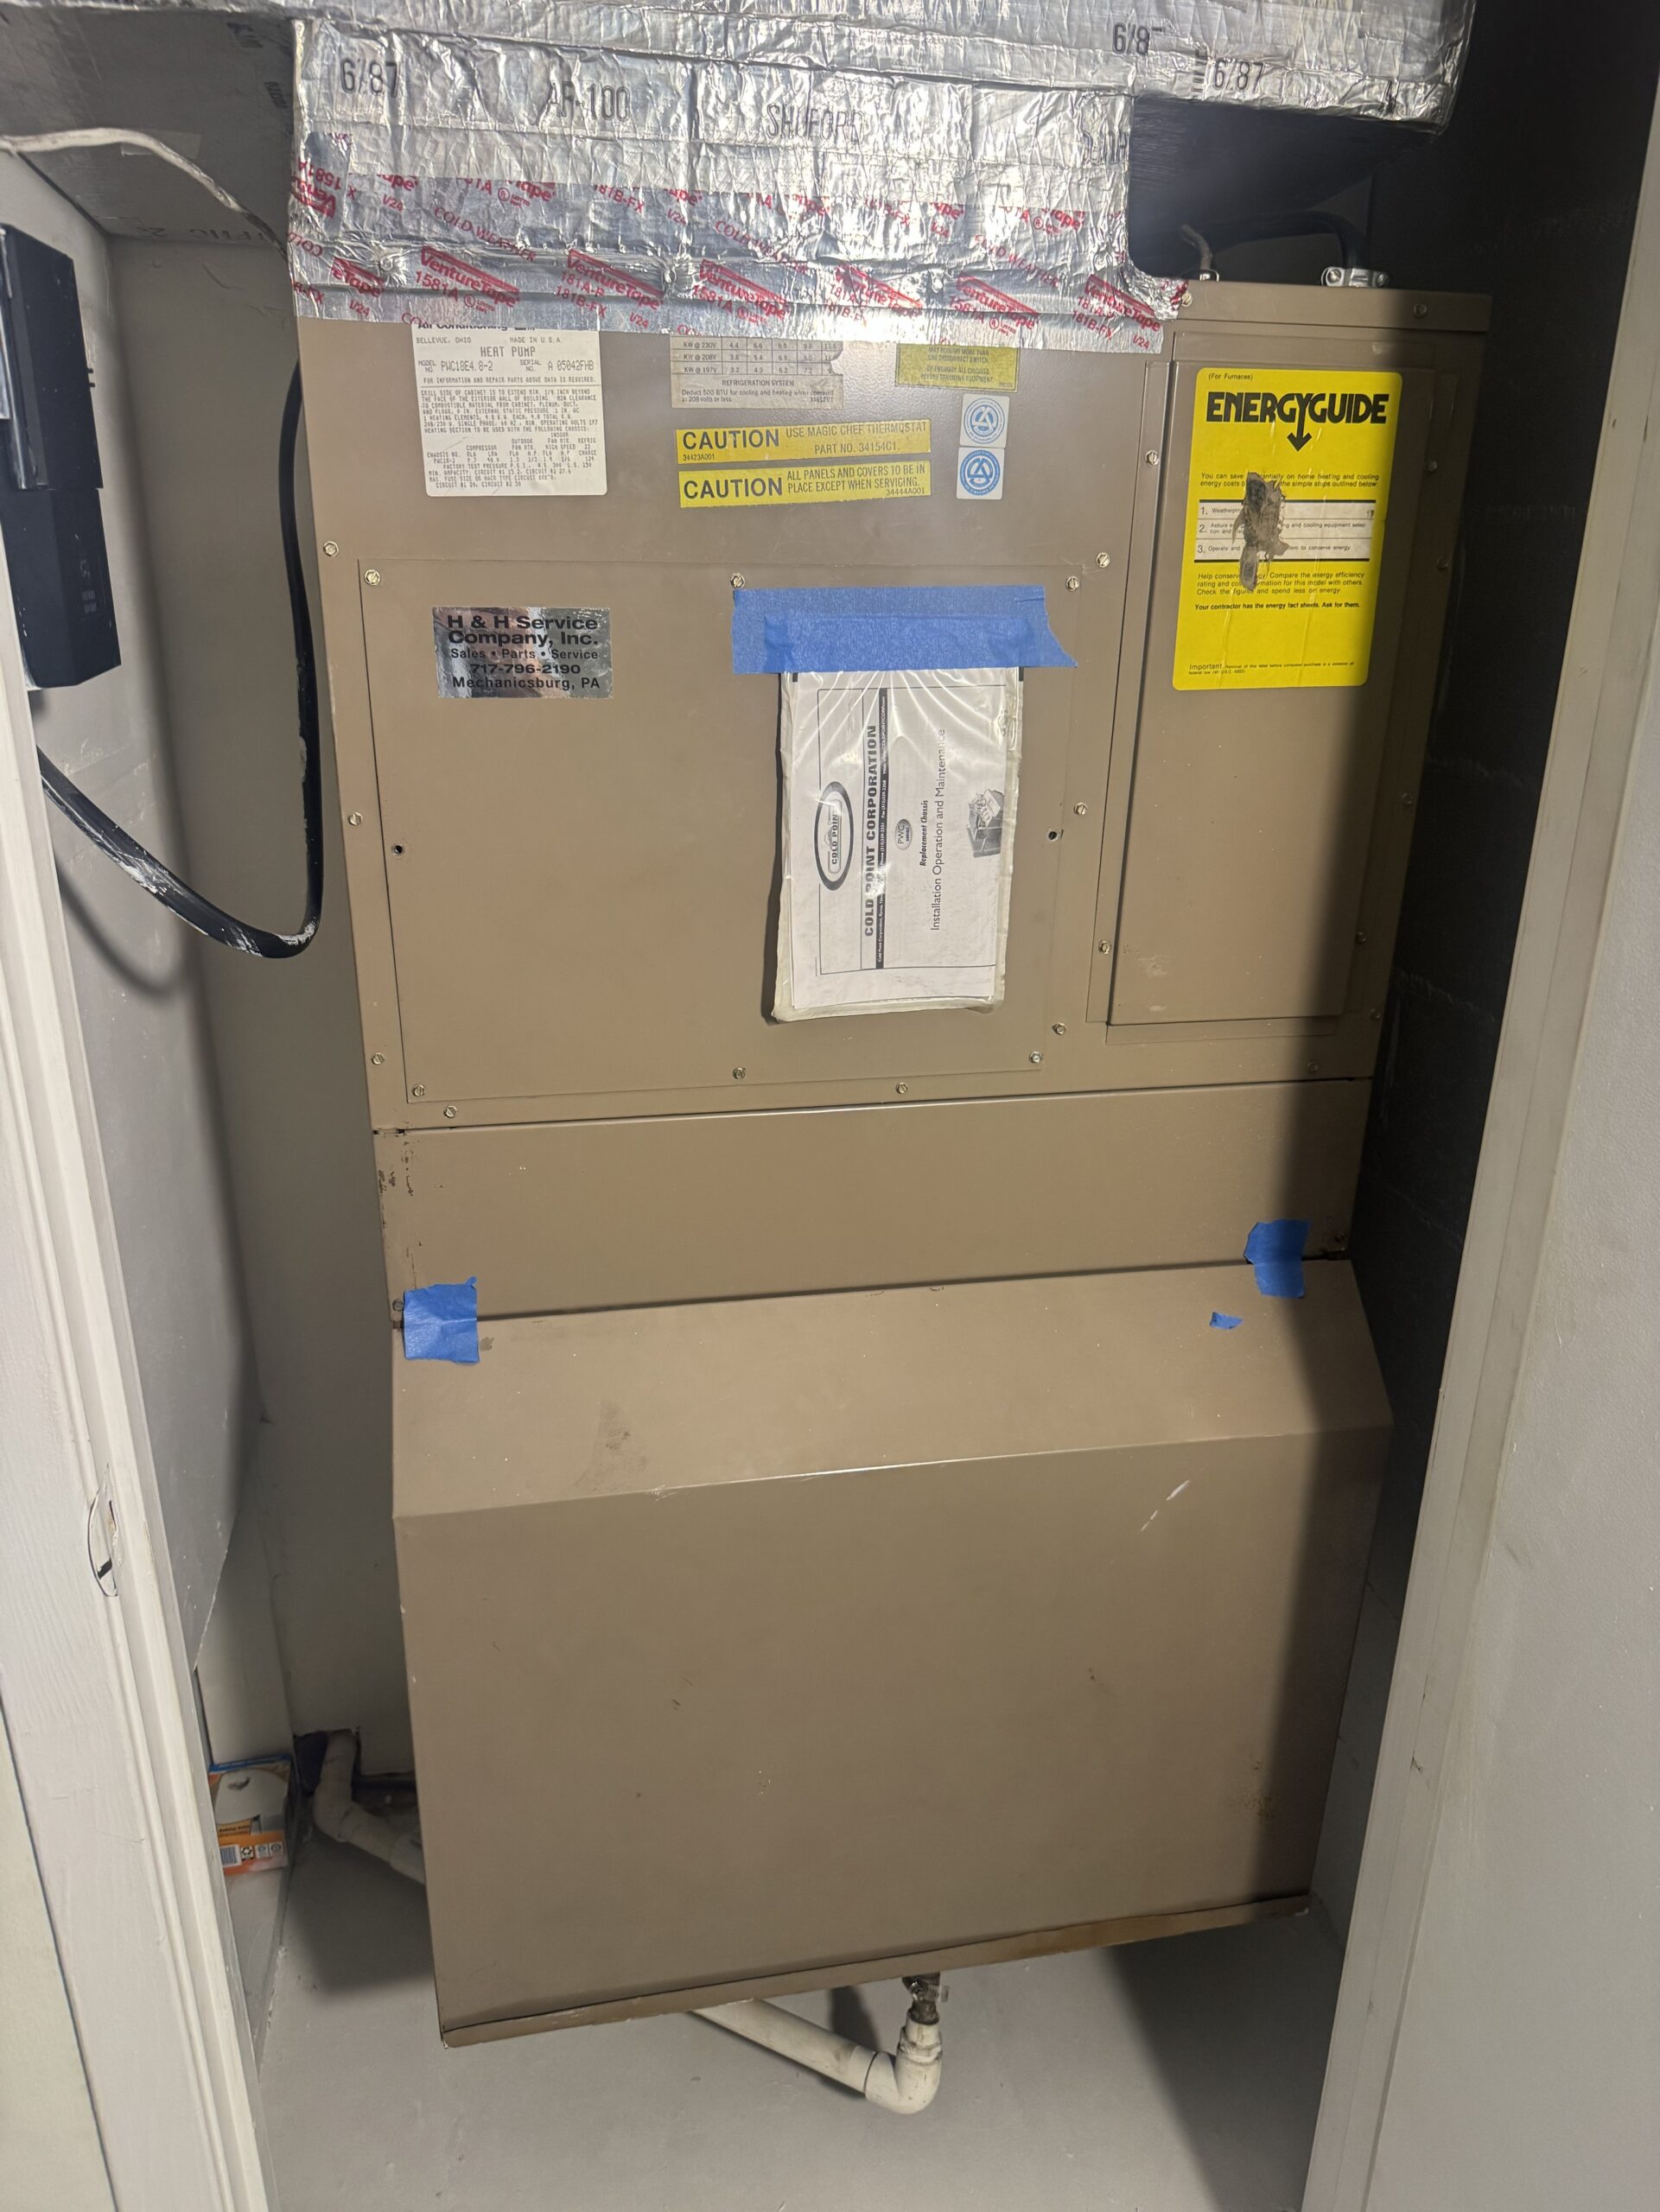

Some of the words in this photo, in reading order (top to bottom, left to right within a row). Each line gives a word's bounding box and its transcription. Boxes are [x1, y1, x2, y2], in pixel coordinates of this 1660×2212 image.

[340, 57, 398, 98] 6/87
[1212, 56, 1264, 93] 6/87
[435, 207, 473, 232] COLD
[416, 270, 458, 301] 1581A
[421, 248, 520, 308] VentureTape
[568, 252, 664, 310] VentureTape
[1084, 278, 1161, 332] VentureTape
[480, 346, 504, 357] HEAT
[512, 346, 536, 357] PUMP
[548, 360, 553, 371] A
[1206, 391, 1390, 424] ENERGYGUIDE
[683, 429, 779, 450] CAUTION
[786, 427, 805, 438] USE
[808, 426, 837, 436] MAGIC
[840, 424, 864, 435] CHEF
[867, 422, 926, 435] THERMOSTAT
[815, 443, 837, 454] PART
[841, 442, 855, 454] NO.
[787, 470, 801, 480] ALL
[805, 468, 836, 480] PANELS
[838, 467, 855, 478] AND
[857, 466, 889, 477] COVERS
[892, 465, 900, 475] TO
[903, 464, 913, 474] BE
[916, 464, 925, 474] IN
[684, 477, 782, 499] CAUTION
[788, 482, 812, 493] PLACE
[816, 480, 845, 492] EXCEPT
[849, 479, 872, 490] WHEN
[875, 477, 919, 488] SERVICING.
[1200, 506, 1207, 515] 1.
[1199, 524, 1207, 533] 2.
[447, 615, 463, 628] H
[471, 615, 486, 629] &
[493, 615, 509, 628] H
[518, 615, 598, 629] Service
[448, 631, 553, 647] Company,
[561, 631, 598, 645] Inc.
[451, 649, 486, 658] Sales
[502, 649, 536, 658] Parts
[551, 649, 598, 659] Service
[470, 664, 581, 674] 717-796-2190
[453, 677, 575, 690] Mechanicsburg,
[582, 677, 600, 689] PA
[935, 728, 945, 797] Maintenance
[867, 726, 877, 841] CORPORATION
[935, 800, 944, 818] and
[919, 825, 928, 866] Replacement
[932, 822, 944, 874] Operation
[866, 847, 875, 893] POINT
[865, 899, 875, 937] COLD
[931, 878, 941, 930] Installation
